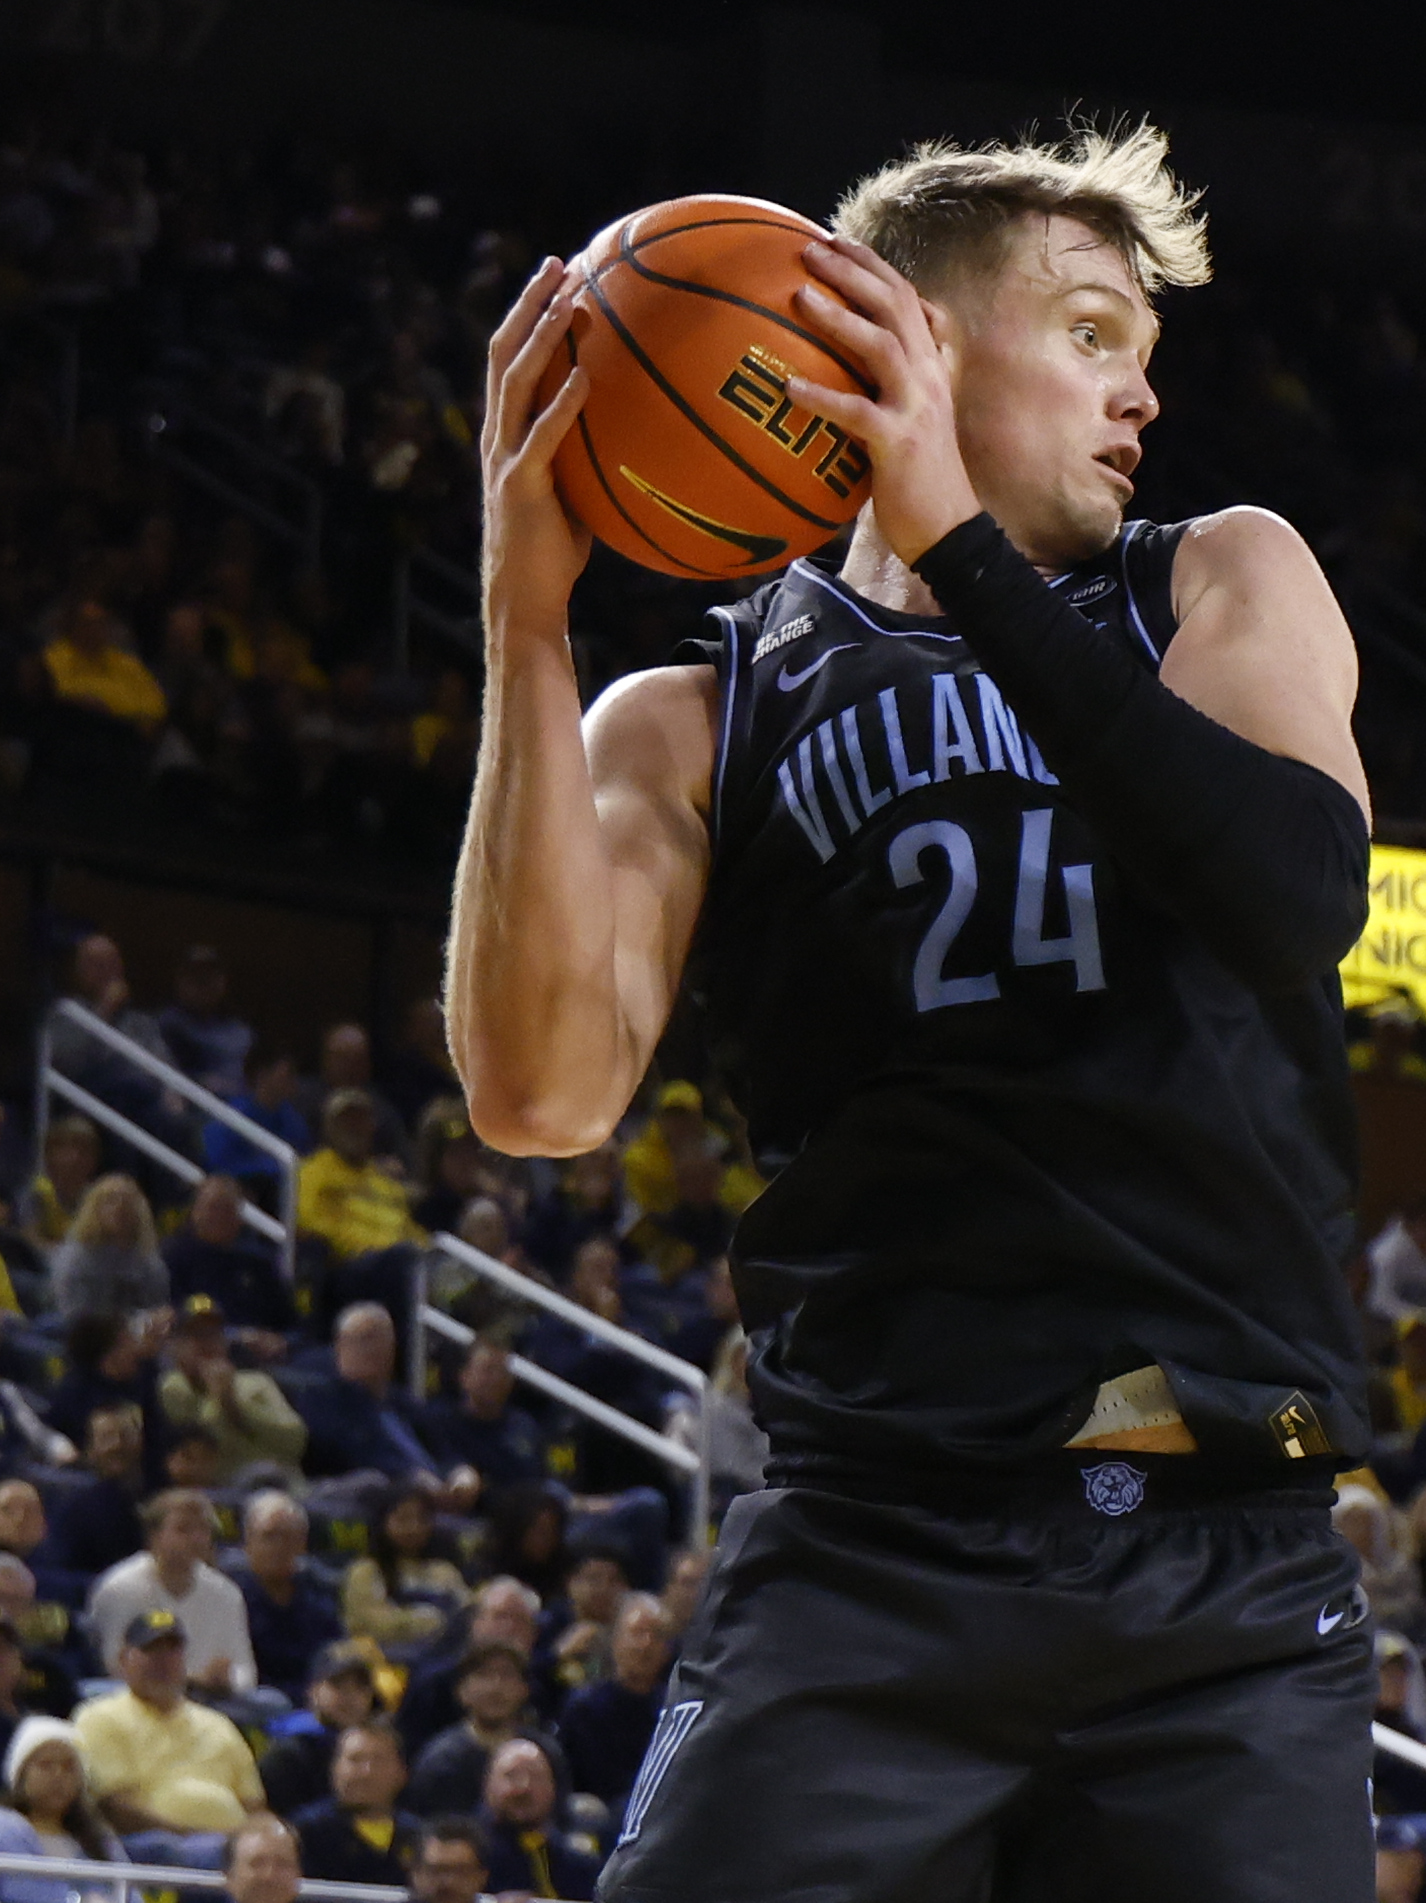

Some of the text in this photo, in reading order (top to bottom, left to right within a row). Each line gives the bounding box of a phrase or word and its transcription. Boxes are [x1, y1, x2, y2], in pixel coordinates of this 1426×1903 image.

[718, 354, 872, 500] ELITE
[780, 613, 811, 634] THE
[888, 807, 1107, 1013] 24
